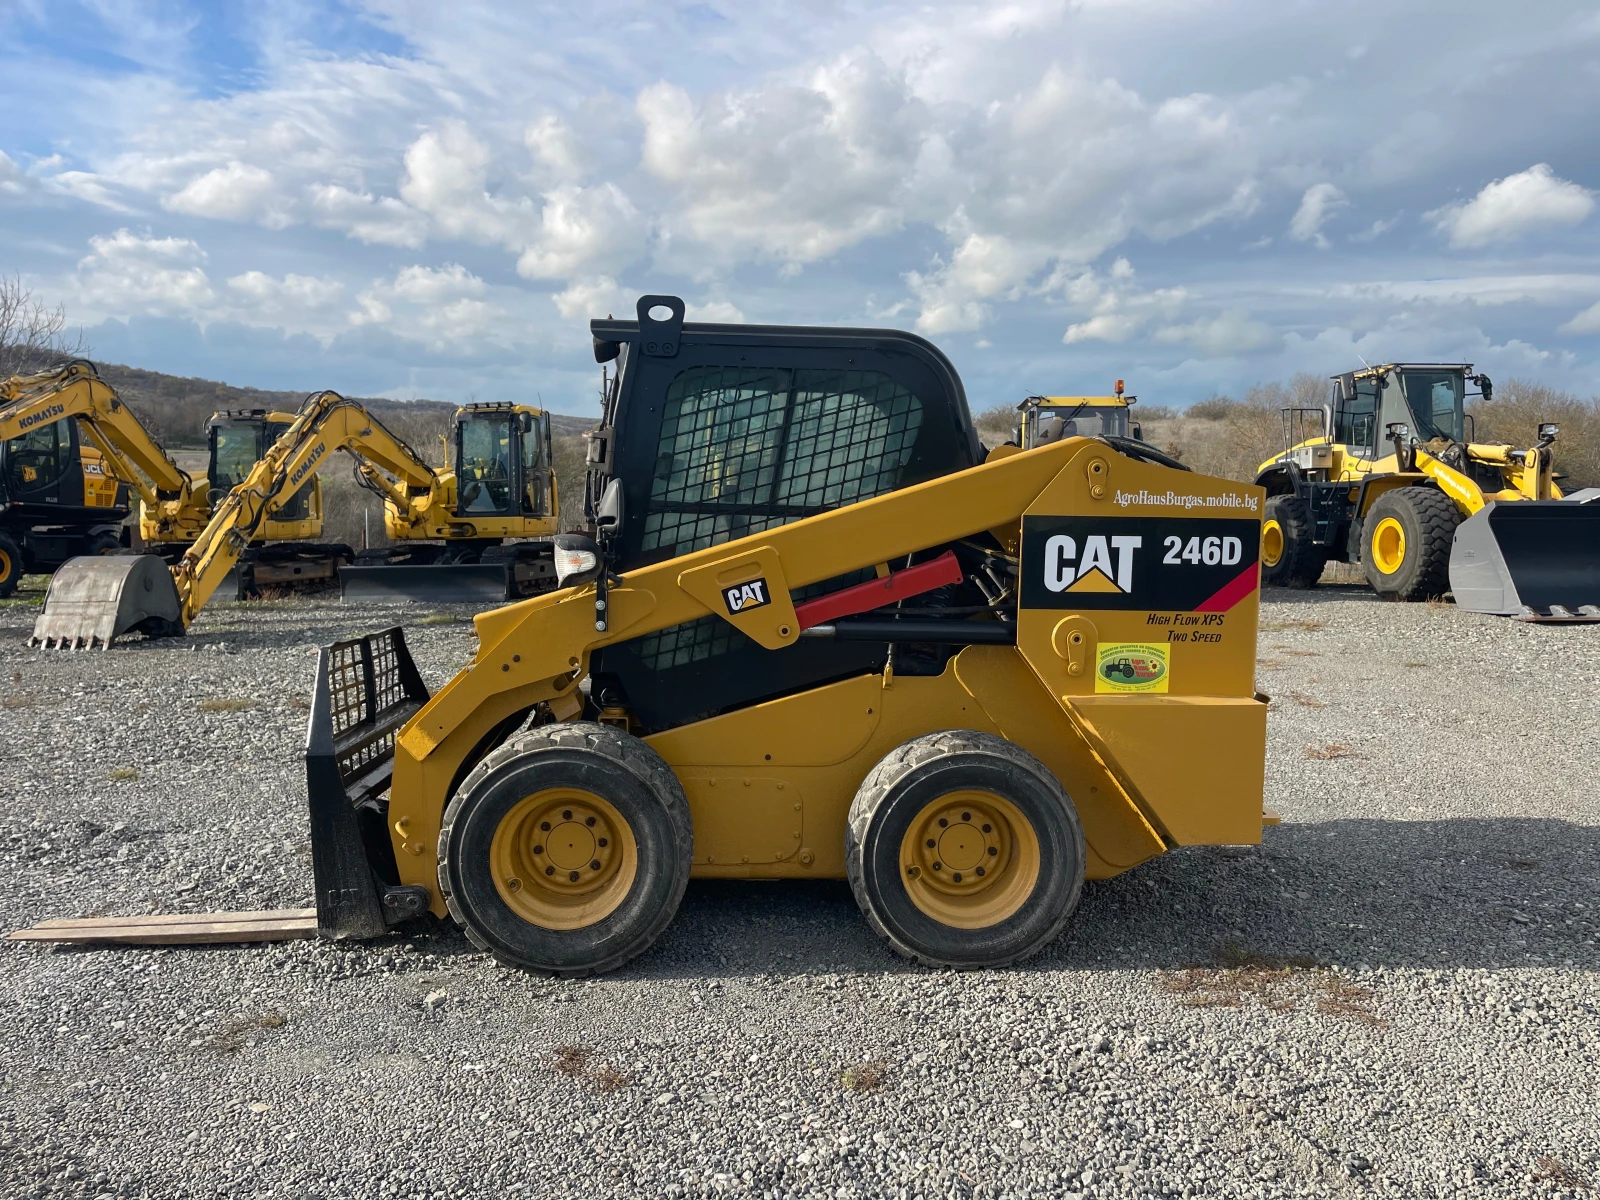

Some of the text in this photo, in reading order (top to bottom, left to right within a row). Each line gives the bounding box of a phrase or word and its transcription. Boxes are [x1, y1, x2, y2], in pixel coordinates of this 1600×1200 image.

[18, 404, 64, 429] KOMATSU
[290, 442, 326, 486] KOMATSU
[1113, 489, 1259, 511] AgroHausBurgas.mobile.bg
[1043, 534, 1242, 593] CAT 246D
[727, 581, 764, 611] CAT
[1200, 614, 1225, 626] XPS
